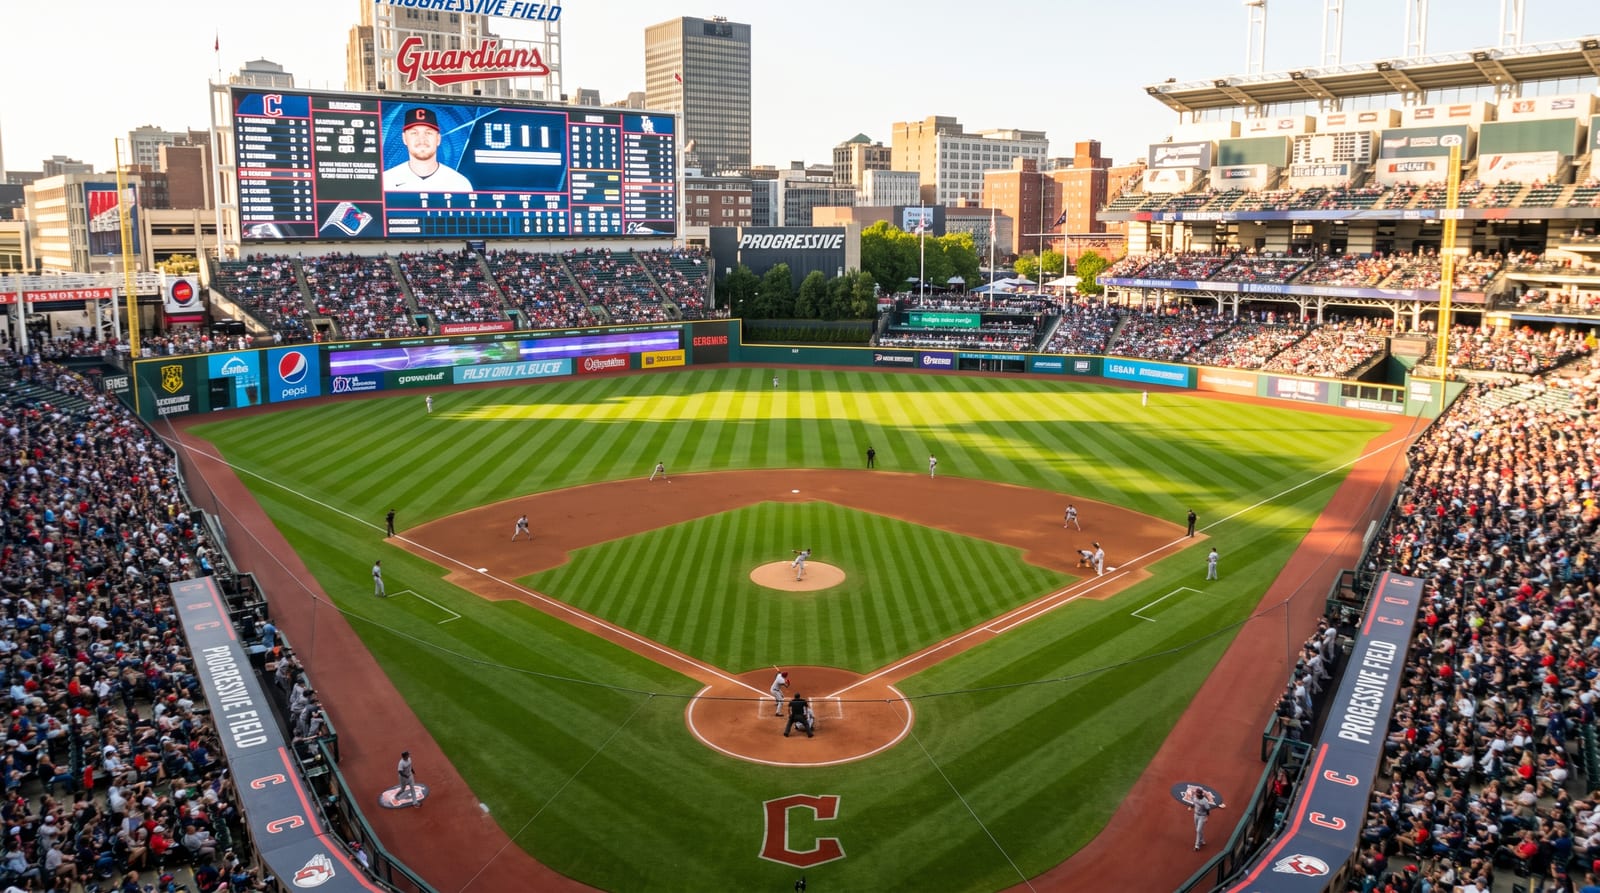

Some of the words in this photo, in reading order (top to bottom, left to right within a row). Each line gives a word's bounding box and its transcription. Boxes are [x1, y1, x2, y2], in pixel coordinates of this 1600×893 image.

[509, 1, 562, 21] FIELD
[396, 36, 550, 86] Guardians
[263, 94, 283, 117] C
[739, 234, 845, 249] PROGRESSIVE
[1369, 640, 1397, 678] FIELD
[226, 710, 268, 748] FIELD
[758, 794, 846, 868] C
